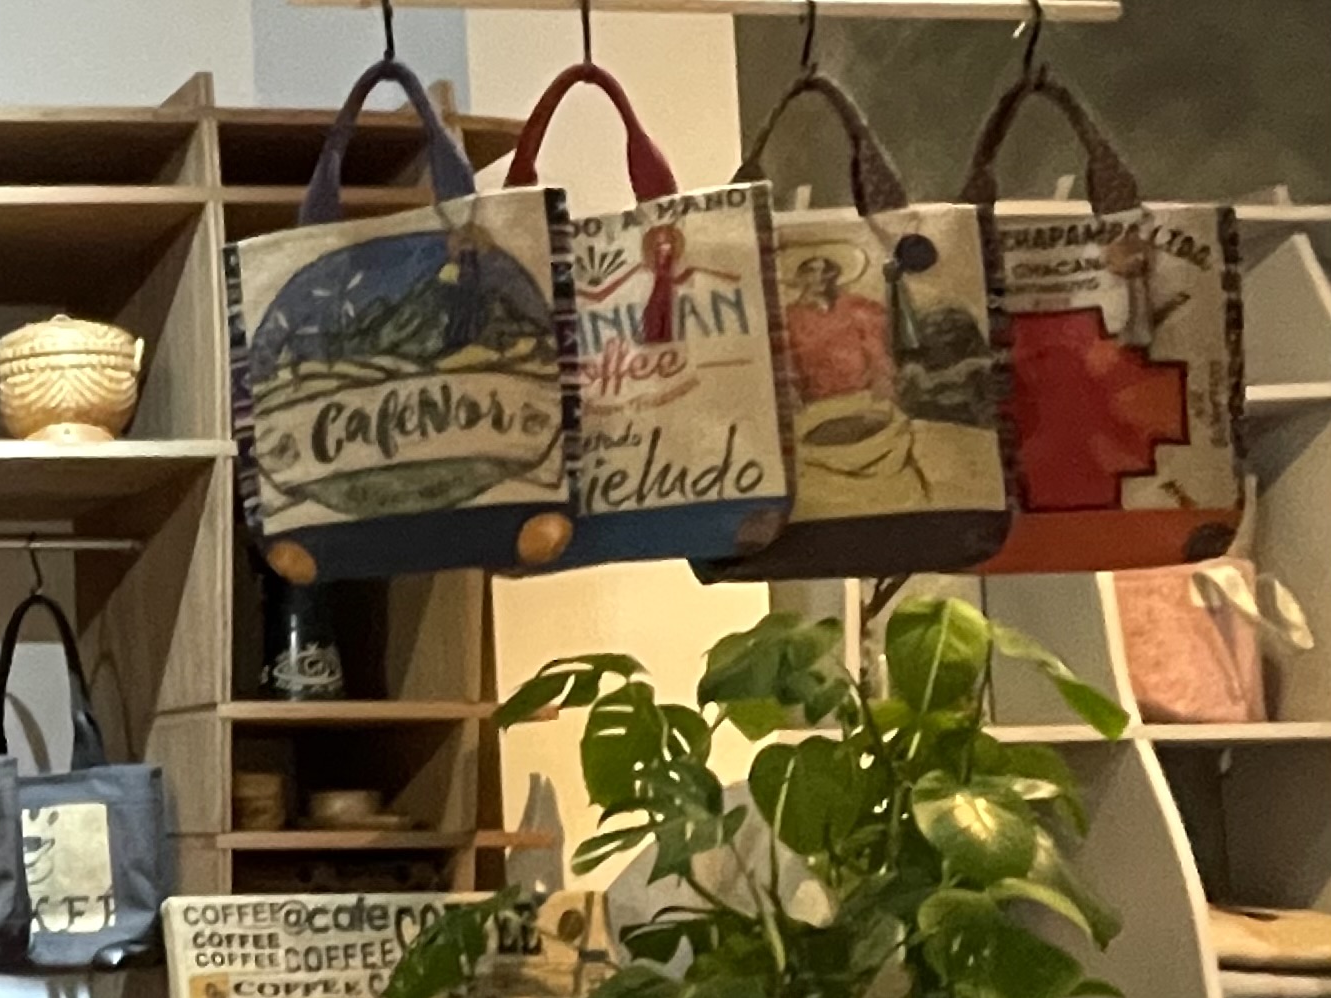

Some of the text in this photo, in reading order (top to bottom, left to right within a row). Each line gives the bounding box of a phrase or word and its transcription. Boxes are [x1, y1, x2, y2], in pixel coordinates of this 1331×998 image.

[192, 930, 281, 950] COFFEE
[195, 938, 397, 973] COFFEE COFFEE
